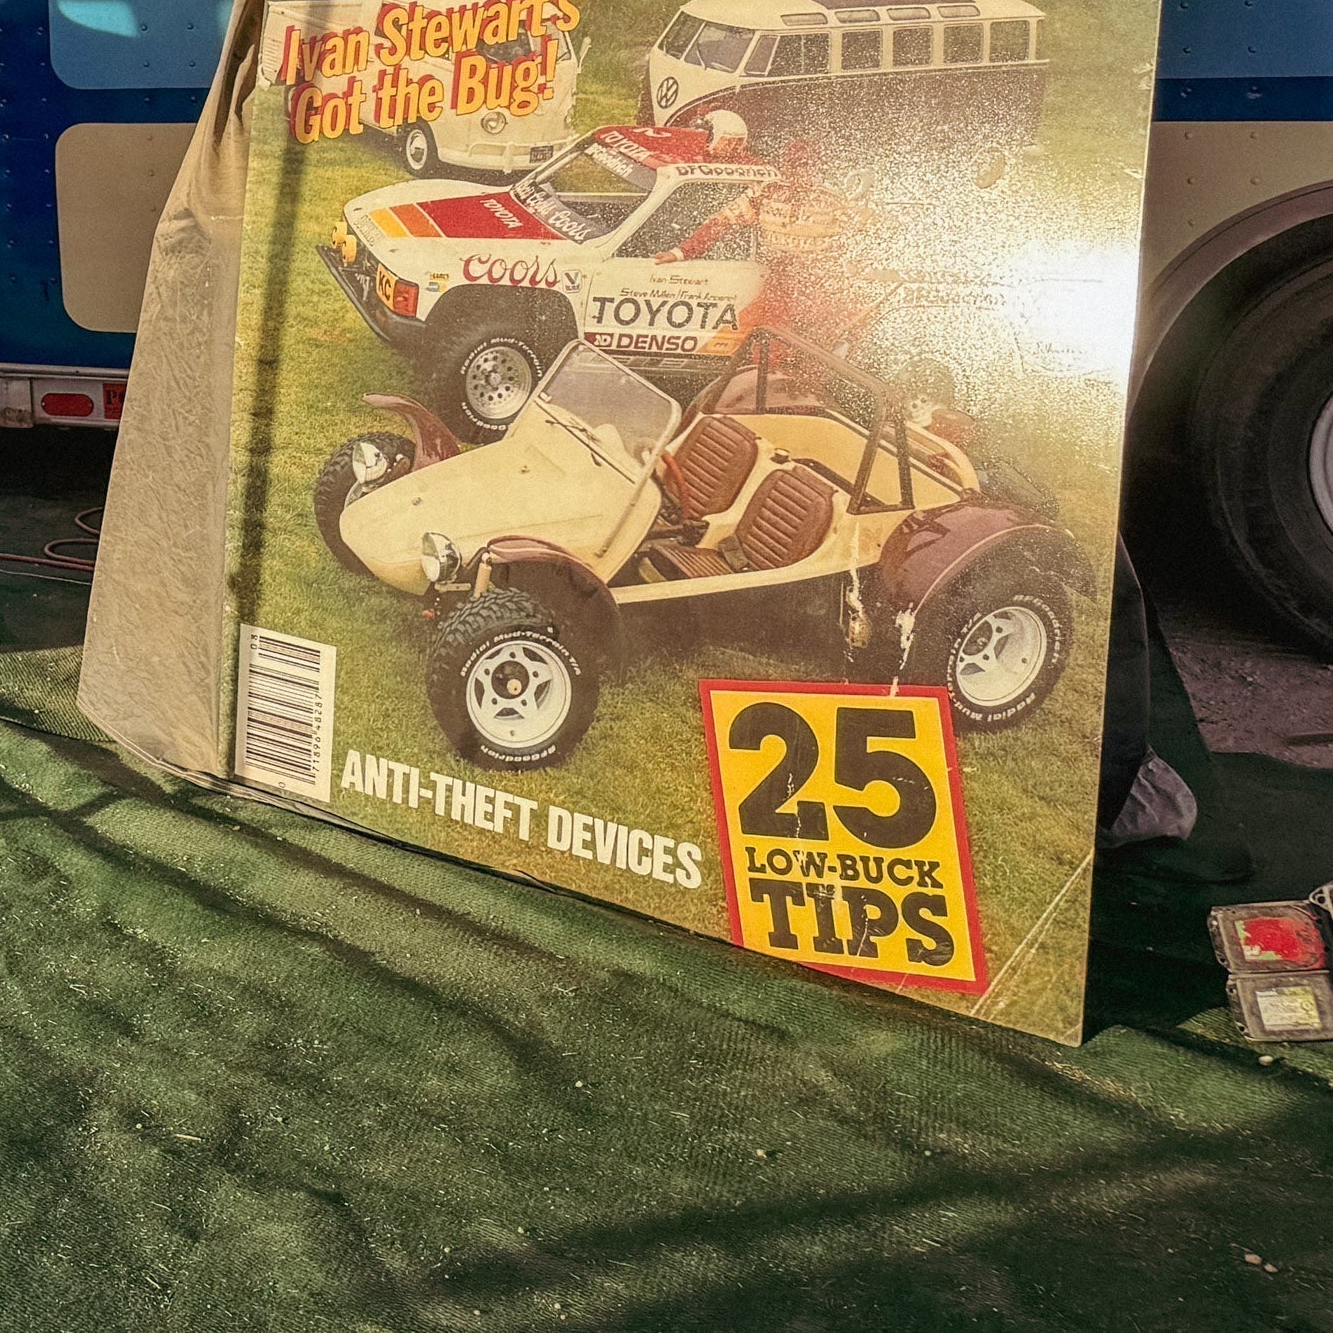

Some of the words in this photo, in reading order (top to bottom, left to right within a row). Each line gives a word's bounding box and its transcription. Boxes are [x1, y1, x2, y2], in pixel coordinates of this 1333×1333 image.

[281, 25, 370, 86] Ivan
[290, 76, 367, 145] Got
[373, 64, 444, 129] the
[450, 34, 559, 117] Bug!
[479, 198, 524, 229] TOYOTA
[592, 296, 739, 331] TOYOTA
[616, 333, 699, 353] DENSO
[728, 701, 937, 850] 25
[340, 749, 539, 841] ANTI-THEFT
[546, 804, 703, 890] DEVICES
[745, 846, 944, 889] LOW-BUCK
[748, 877, 955, 967] TIPS
